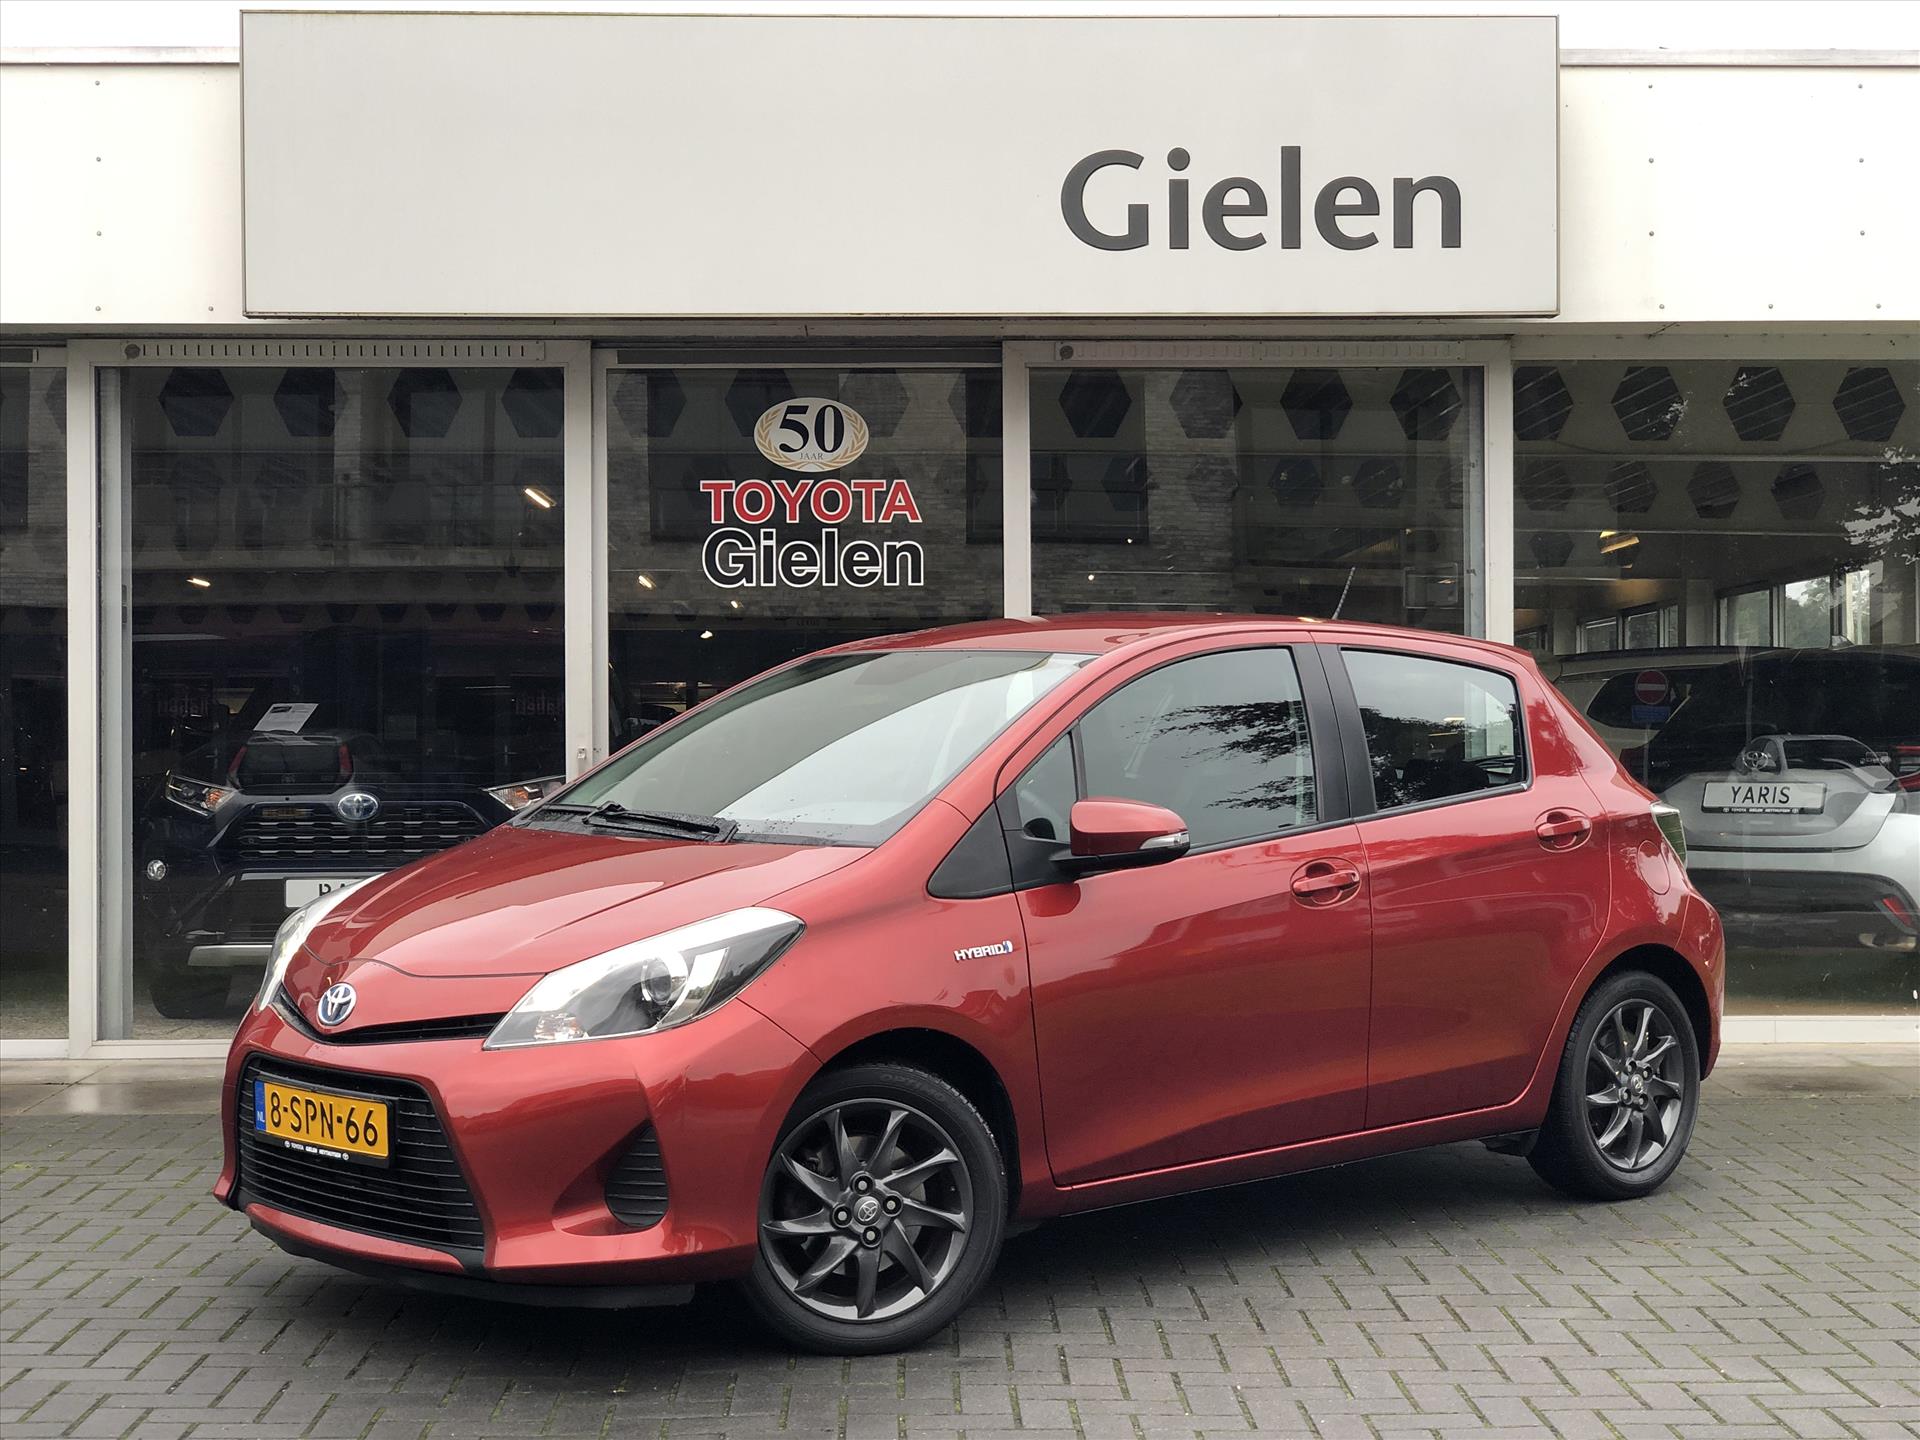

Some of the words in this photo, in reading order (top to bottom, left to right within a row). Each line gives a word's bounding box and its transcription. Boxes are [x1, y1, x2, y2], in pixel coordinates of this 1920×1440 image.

[1060, 146, 1462, 252] Gielen
[778, 404, 845, 453] 50
[800, 453, 824, 461] JAAR
[700, 479, 923, 523] TOYOTA
[702, 527, 924, 587] Gielen
[1731, 786, 1791, 804] YARIS
[954, 943, 1006, 961] HYBRID
[256, 1111, 265, 1123] NL
[270, 1091, 378, 1146] 8-SPN-66
